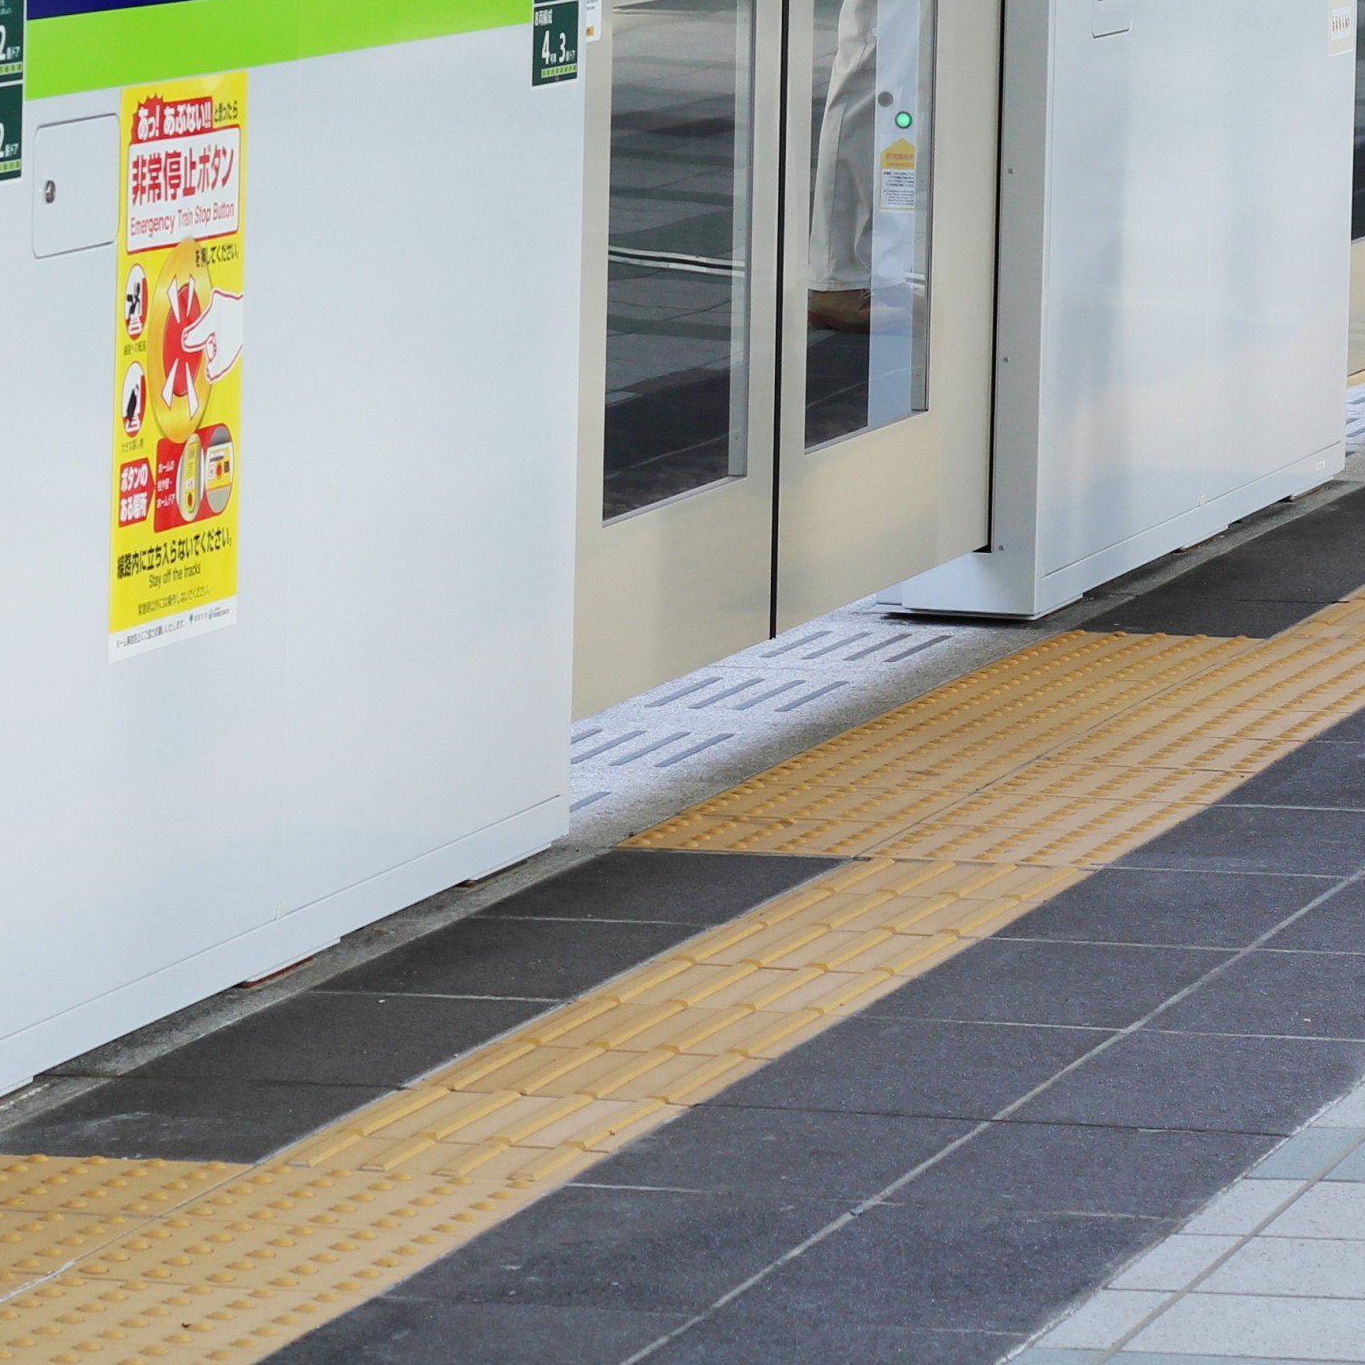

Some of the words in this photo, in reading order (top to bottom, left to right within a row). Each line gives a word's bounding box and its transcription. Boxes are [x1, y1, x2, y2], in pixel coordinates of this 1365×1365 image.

[132, 144, 234, 207] 非常停止ボタン
[131, 216, 176, 238] Emergency
[178, 209, 193, 228] Train
[195, 206, 210, 227] Stop
[213, 202, 235, 221] Button
[120, 463, 148, 493] ボタンの
[119, 492, 147, 522] ある場所
[148, 573, 163, 589] Stay
[163, 570, 172, 583] off
[172, 567, 183, 581] the
[183, 562, 201, 579] tracks
